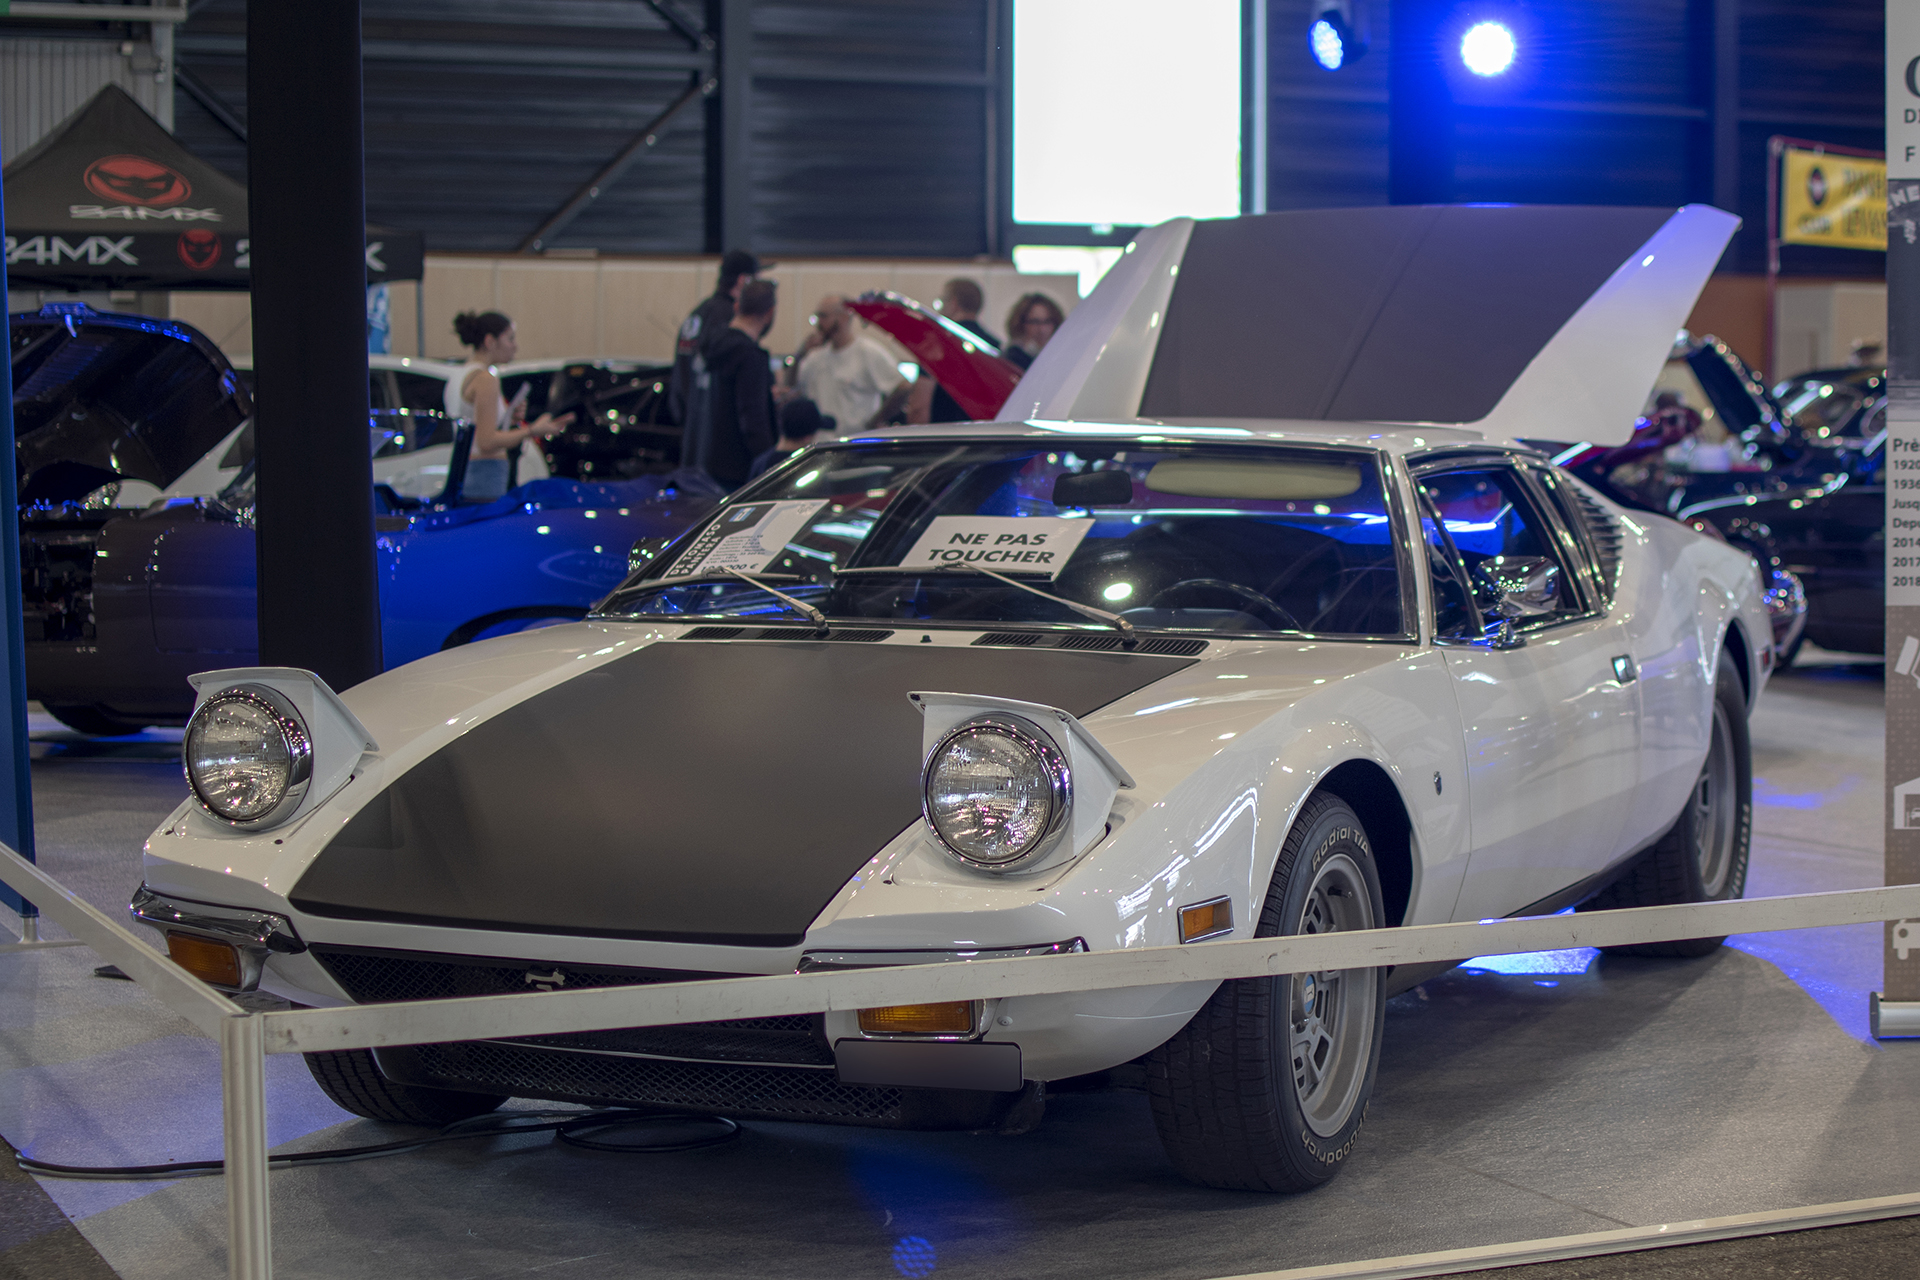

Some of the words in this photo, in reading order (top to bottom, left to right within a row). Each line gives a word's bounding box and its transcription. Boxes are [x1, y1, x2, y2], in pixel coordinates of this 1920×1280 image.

[669, 564, 685, 576] DE
[682, 524, 721, 561] TOMASO
[680, 536, 721, 575] PANTERA
[927, 549, 1055, 564] TOUCHER
[948, 533, 989, 545] NE
[994, 533, 1048, 546] PAS
[1312, 826, 1351, 873] Radial
